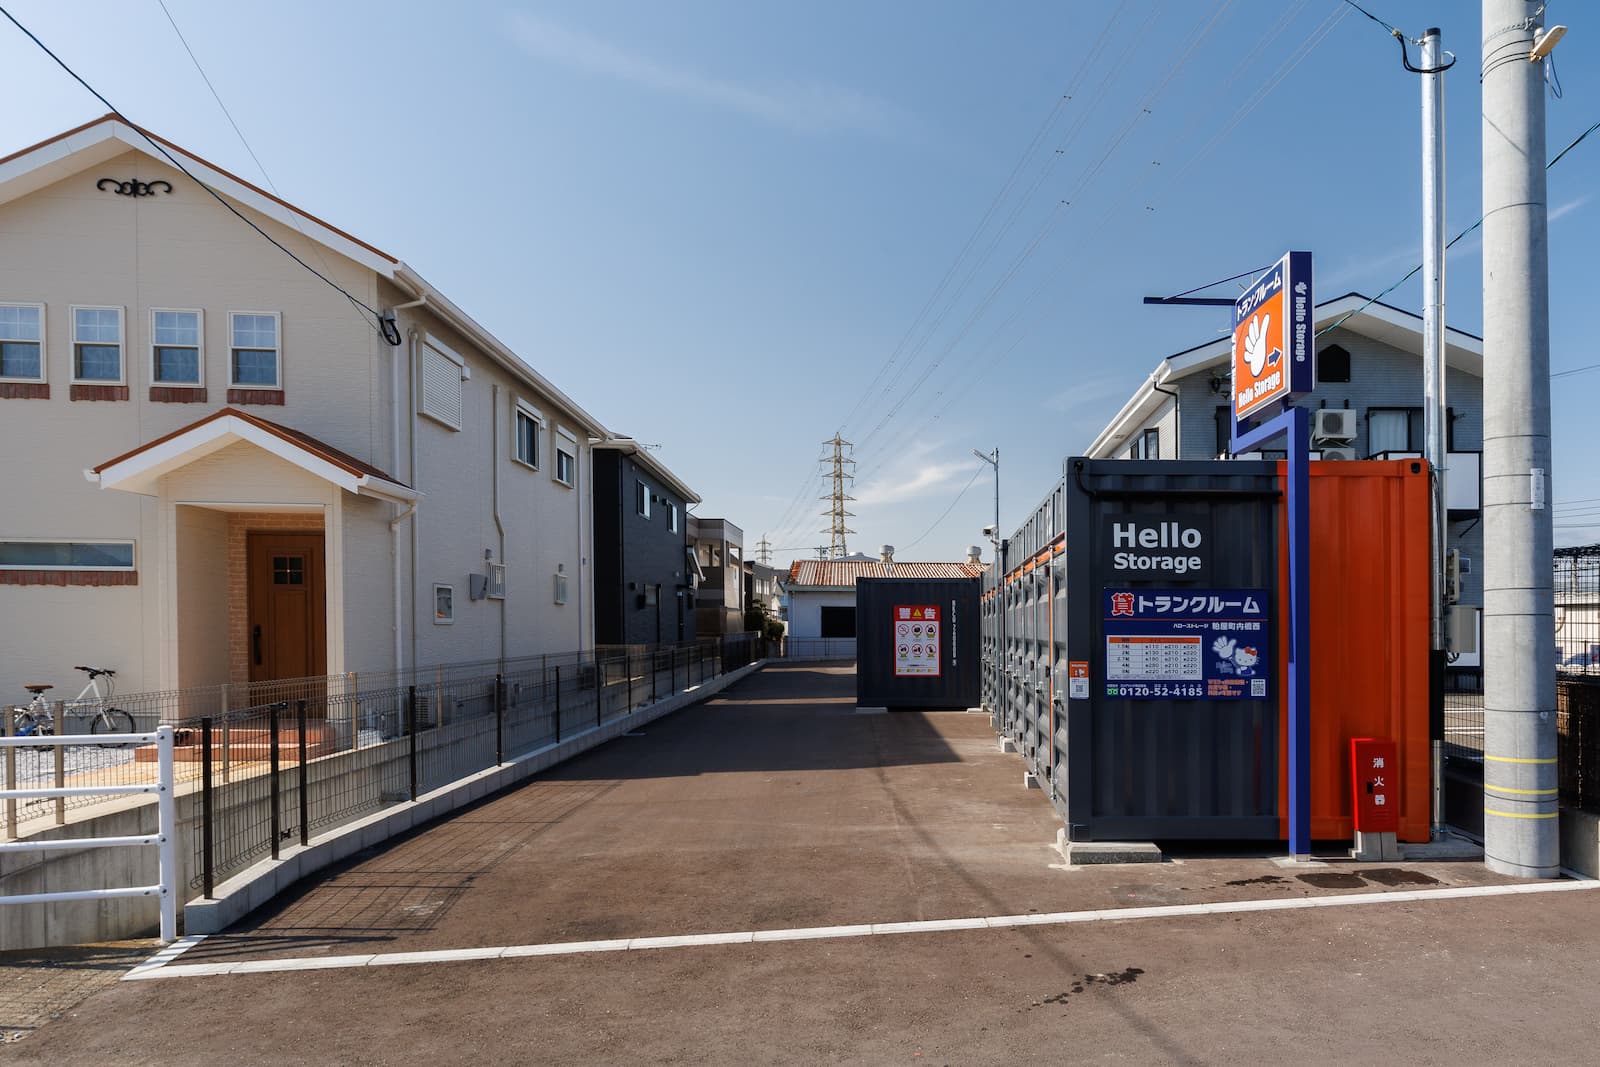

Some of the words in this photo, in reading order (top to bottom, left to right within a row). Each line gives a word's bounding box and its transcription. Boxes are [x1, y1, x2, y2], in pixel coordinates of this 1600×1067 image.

[1237, 272, 1281, 321] トランクルーム
[1295, 296, 1306, 321] Hello
[1295, 323, 1306, 362] Storage
[1238, 386, 1253, 408] Hello
[1254, 370, 1280, 397] Storage
[1113, 522, 1202, 548] Hello
[1113, 552, 1202, 574] Storage
[1119, 687, 1203, 697] 0120-52-4185
